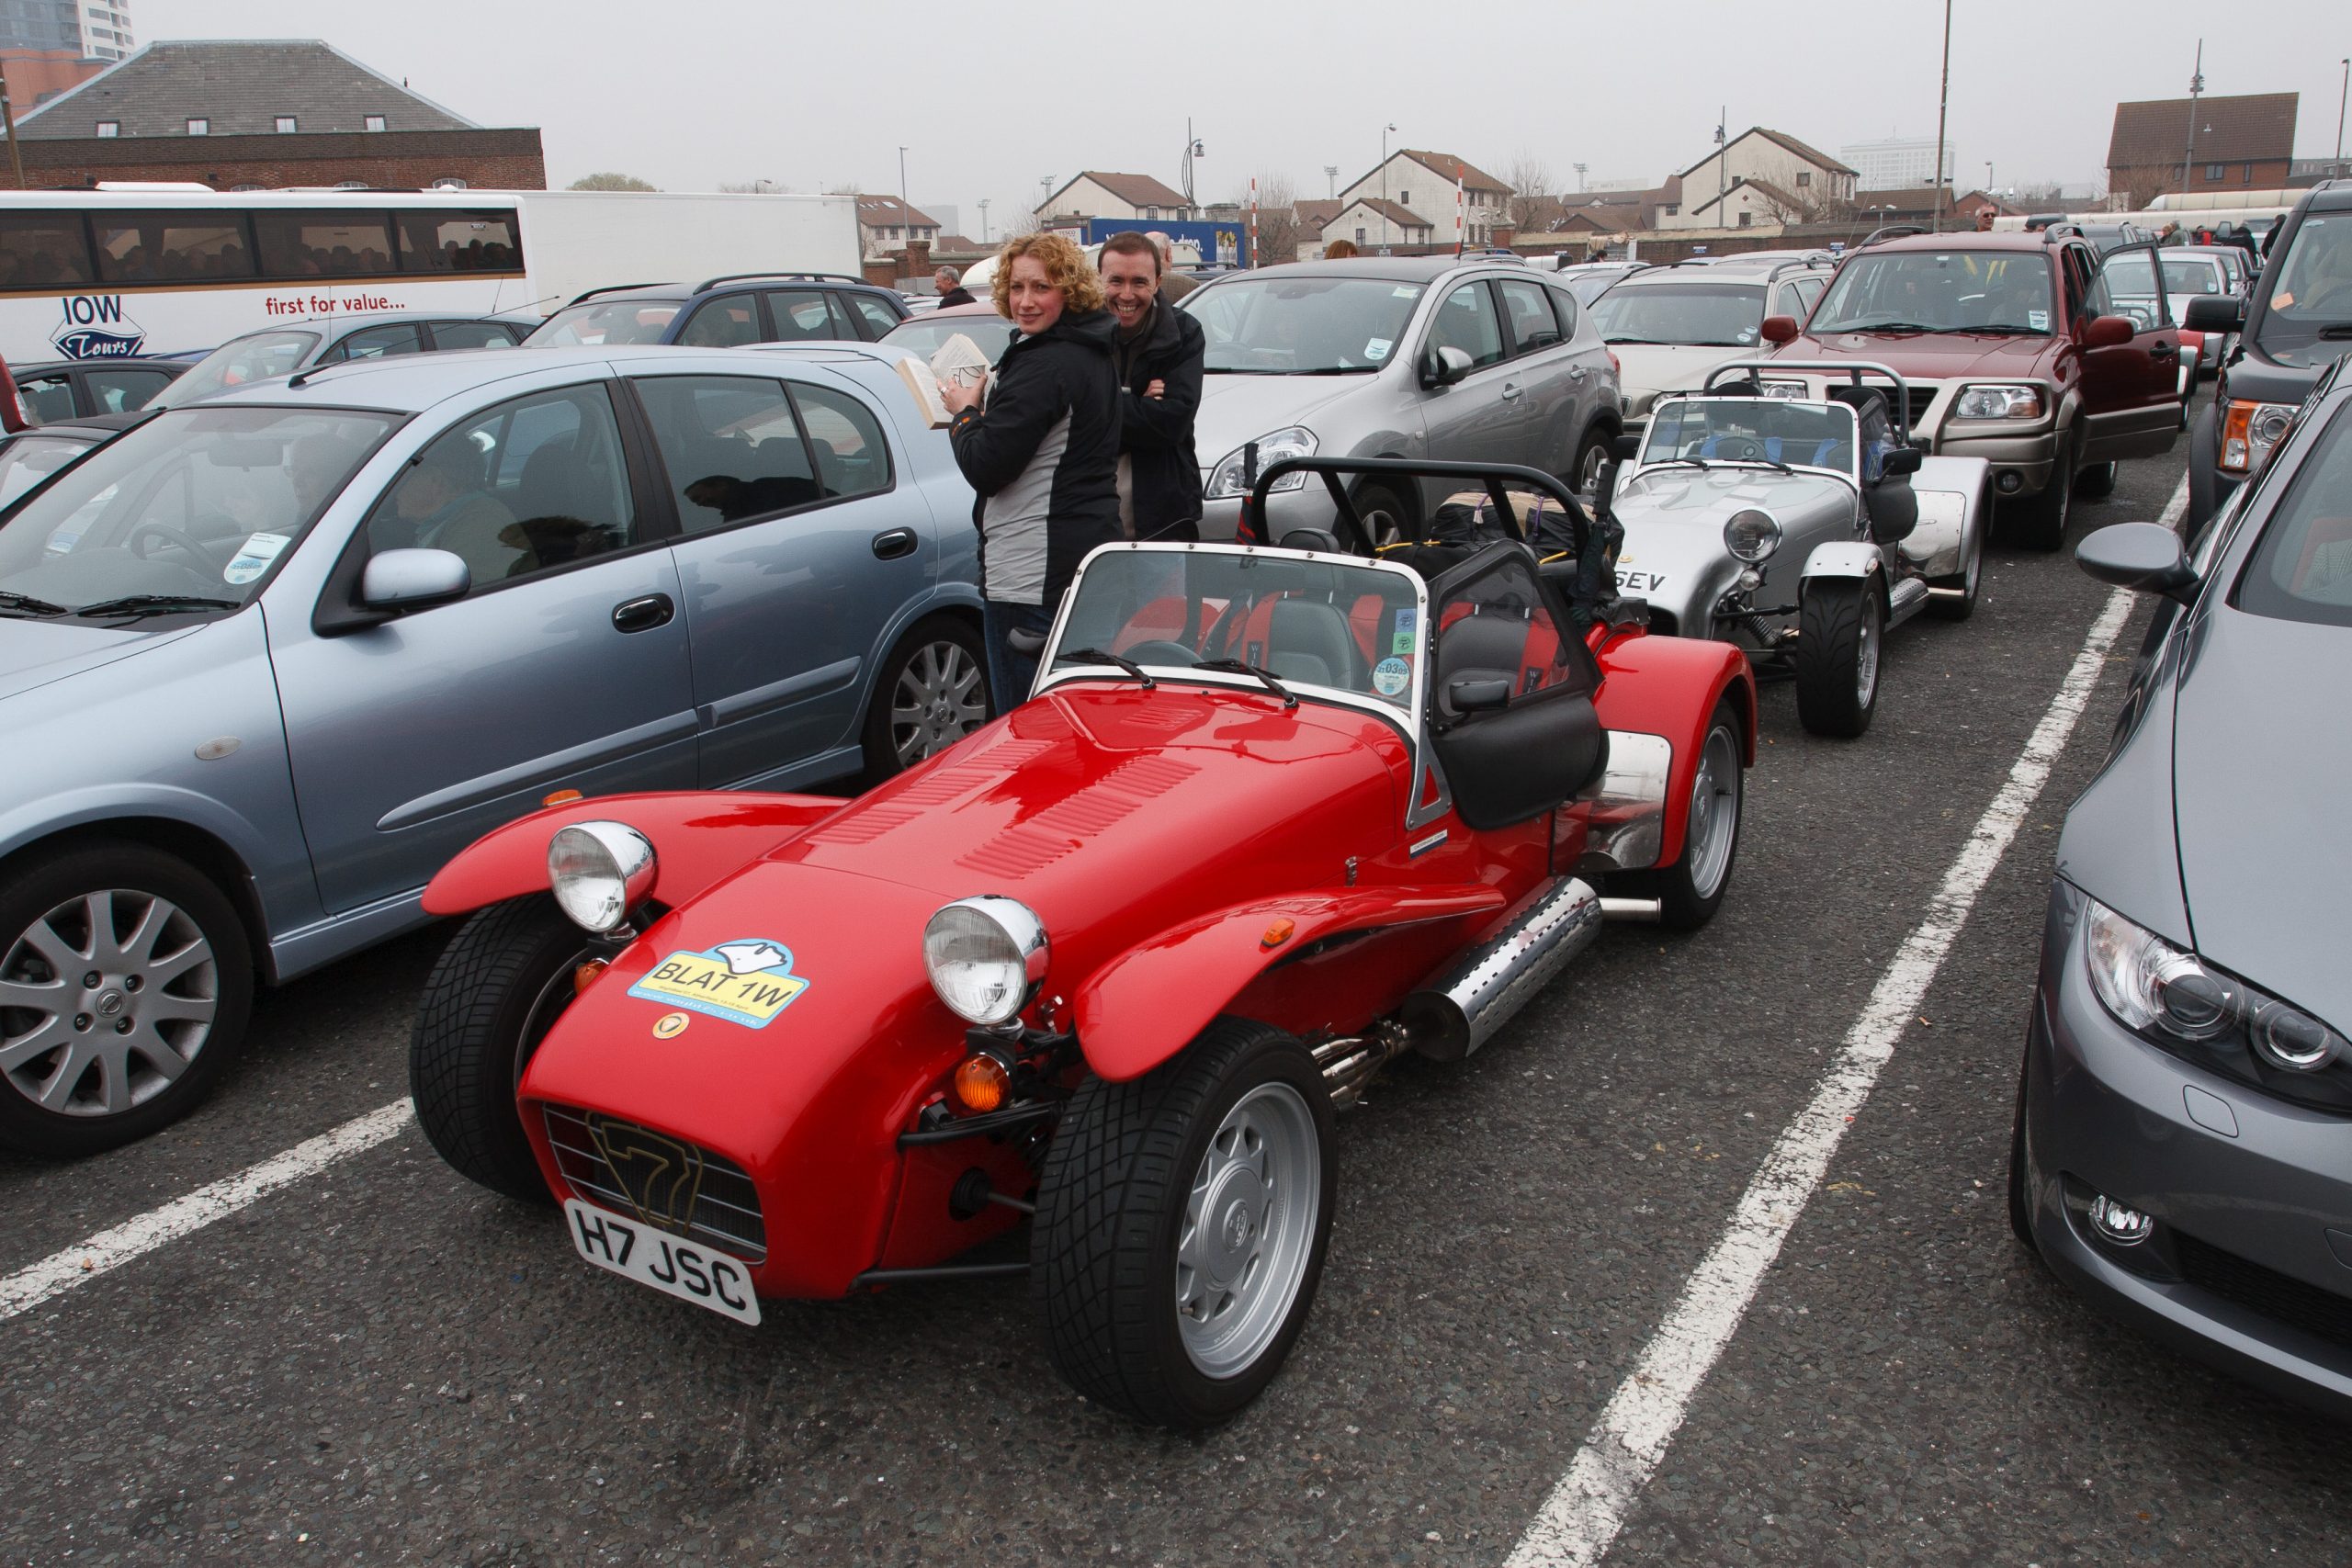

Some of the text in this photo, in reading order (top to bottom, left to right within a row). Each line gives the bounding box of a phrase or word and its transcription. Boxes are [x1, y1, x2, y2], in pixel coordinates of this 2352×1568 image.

[62, 295, 121, 325] IOW
[266, 293, 405, 315] first for value...
[66, 334, 128, 358] Tours
[651, 962, 793, 1008] BLAT 1W
[573, 1208, 747, 1312] H7 JSC
